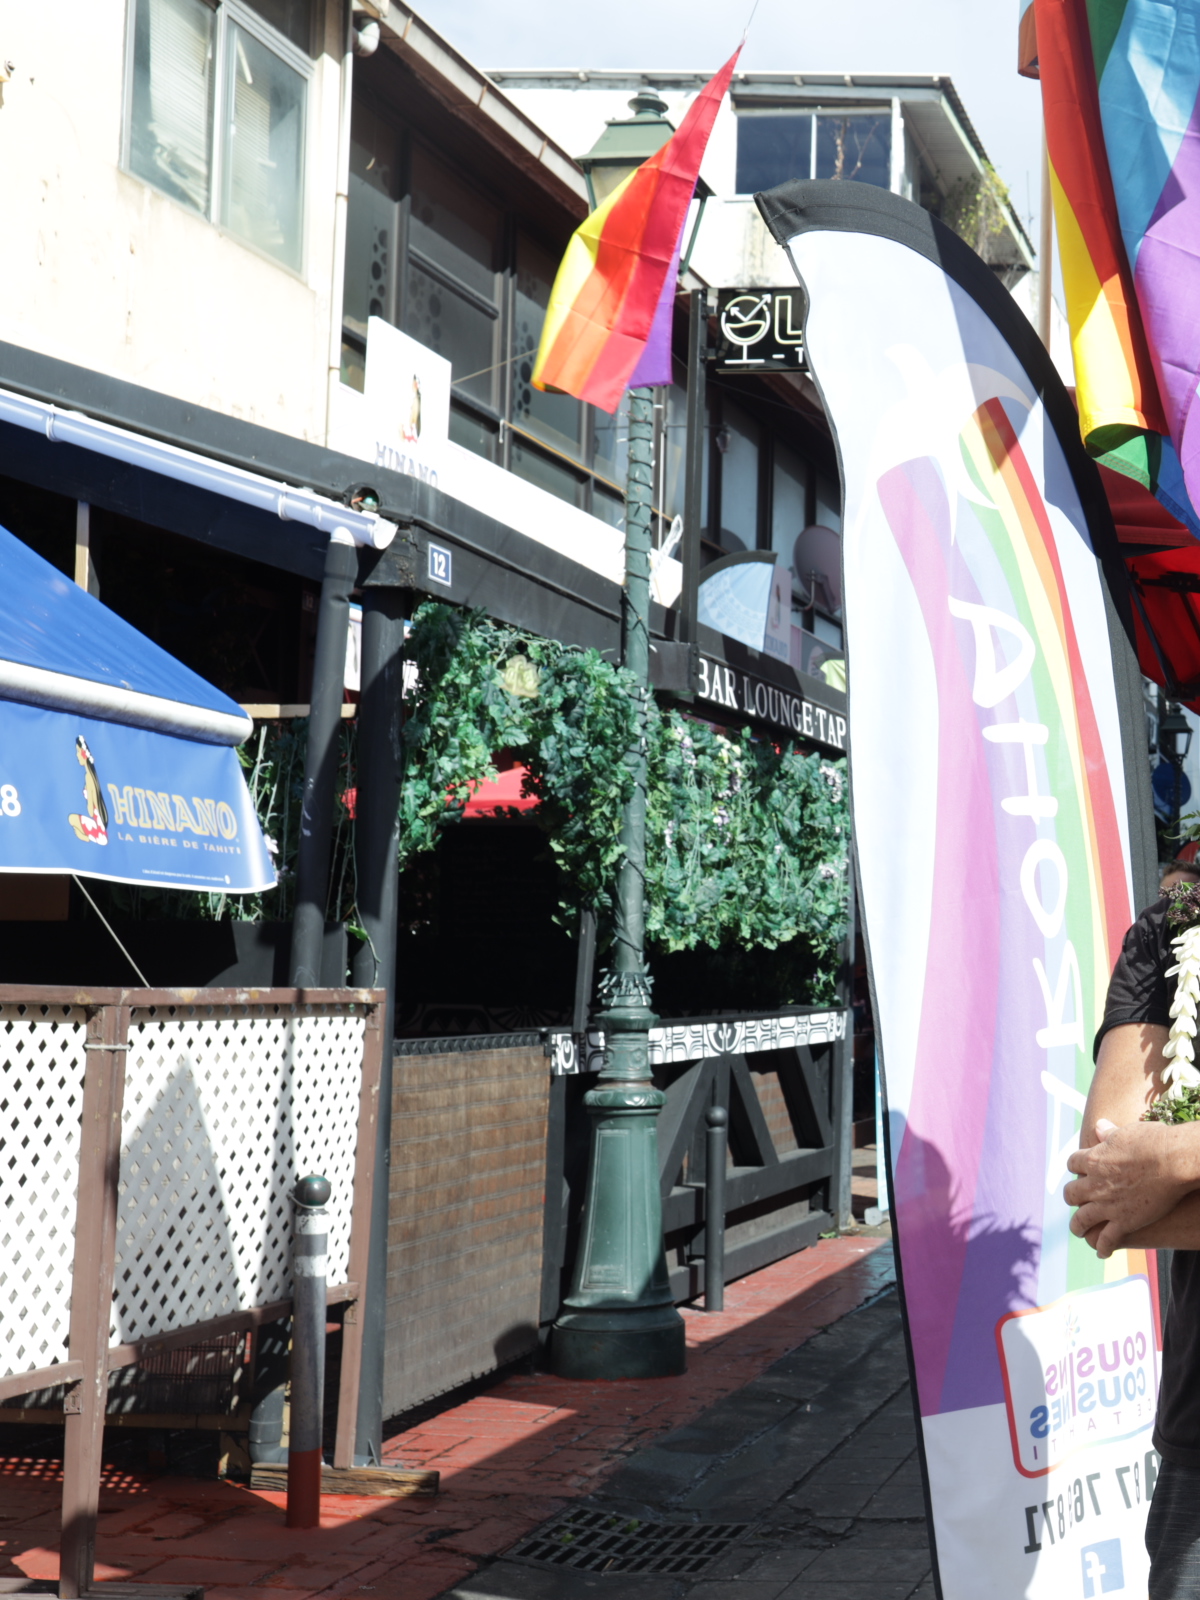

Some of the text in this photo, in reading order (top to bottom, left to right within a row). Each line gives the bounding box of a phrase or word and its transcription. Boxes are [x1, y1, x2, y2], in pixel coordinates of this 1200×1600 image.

[375, 441, 439, 488] HINANO
[433, 551, 446, 577] 12
[743, 676, 814, 736] LOUNGE
[107, 783, 237, 840] HINANO
[118, 831, 242, 854] LA BIÈRE DE TAHITI
